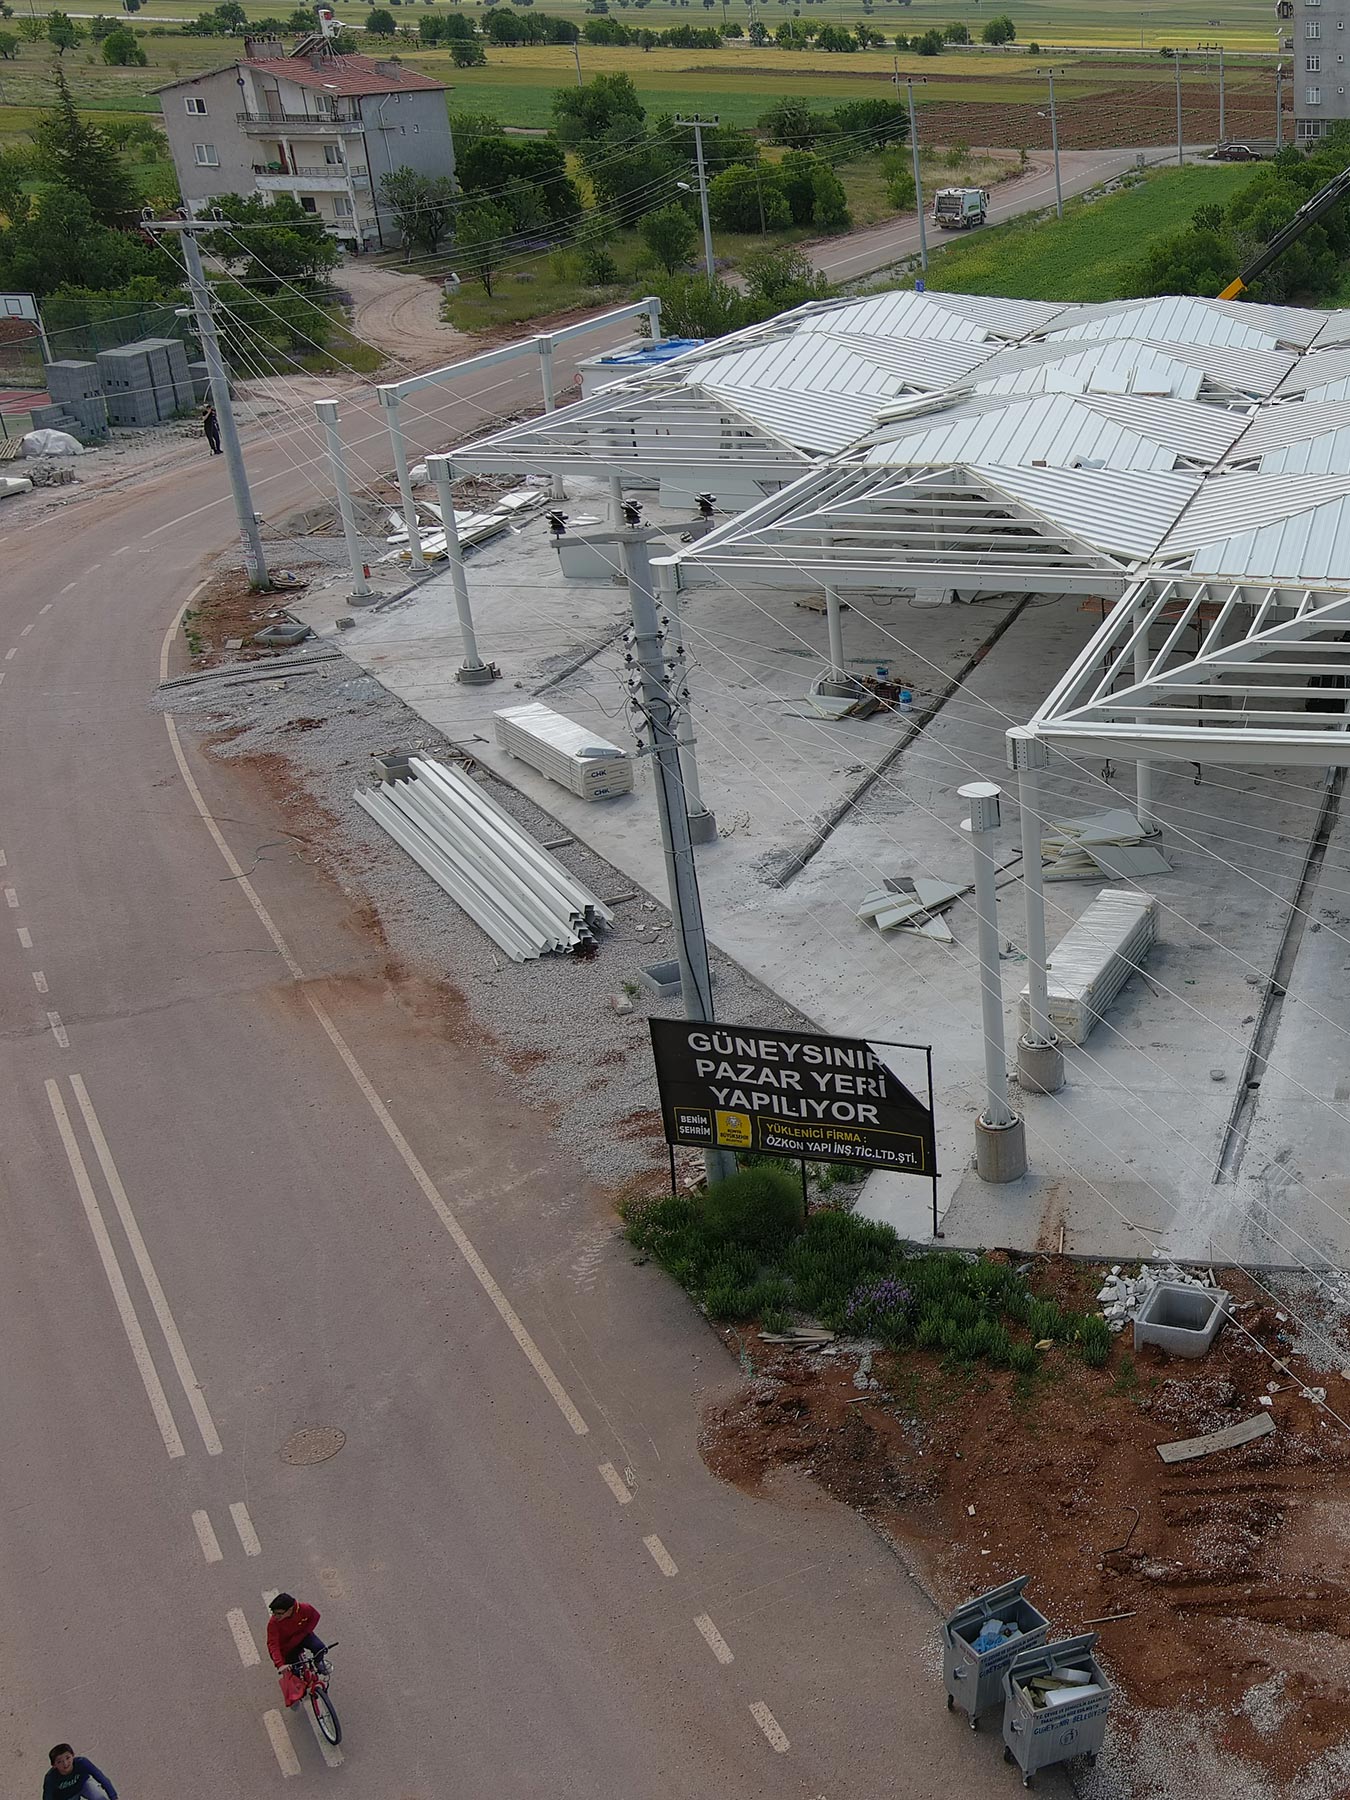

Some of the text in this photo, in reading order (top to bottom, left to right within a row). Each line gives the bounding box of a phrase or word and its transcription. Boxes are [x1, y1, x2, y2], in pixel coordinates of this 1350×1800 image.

[591, 770, 607, 778] CHK
[594, 788, 610, 796] CHK
[696, 1059, 887, 1099] PAZAR YERİ
[709, 1085, 880, 1125] YAPILIYOR
[681, 1114, 708, 1125] BENİM
[680, 1125, 711, 1136] ŞEHRİM
[766, 1123, 824, 1139] YÜKLENİCİ
[826, 1129, 861, 1142] FİRMA
[766, 1134, 804, 1151] ÖZKON
[806, 1142, 831, 1153] YAPI
